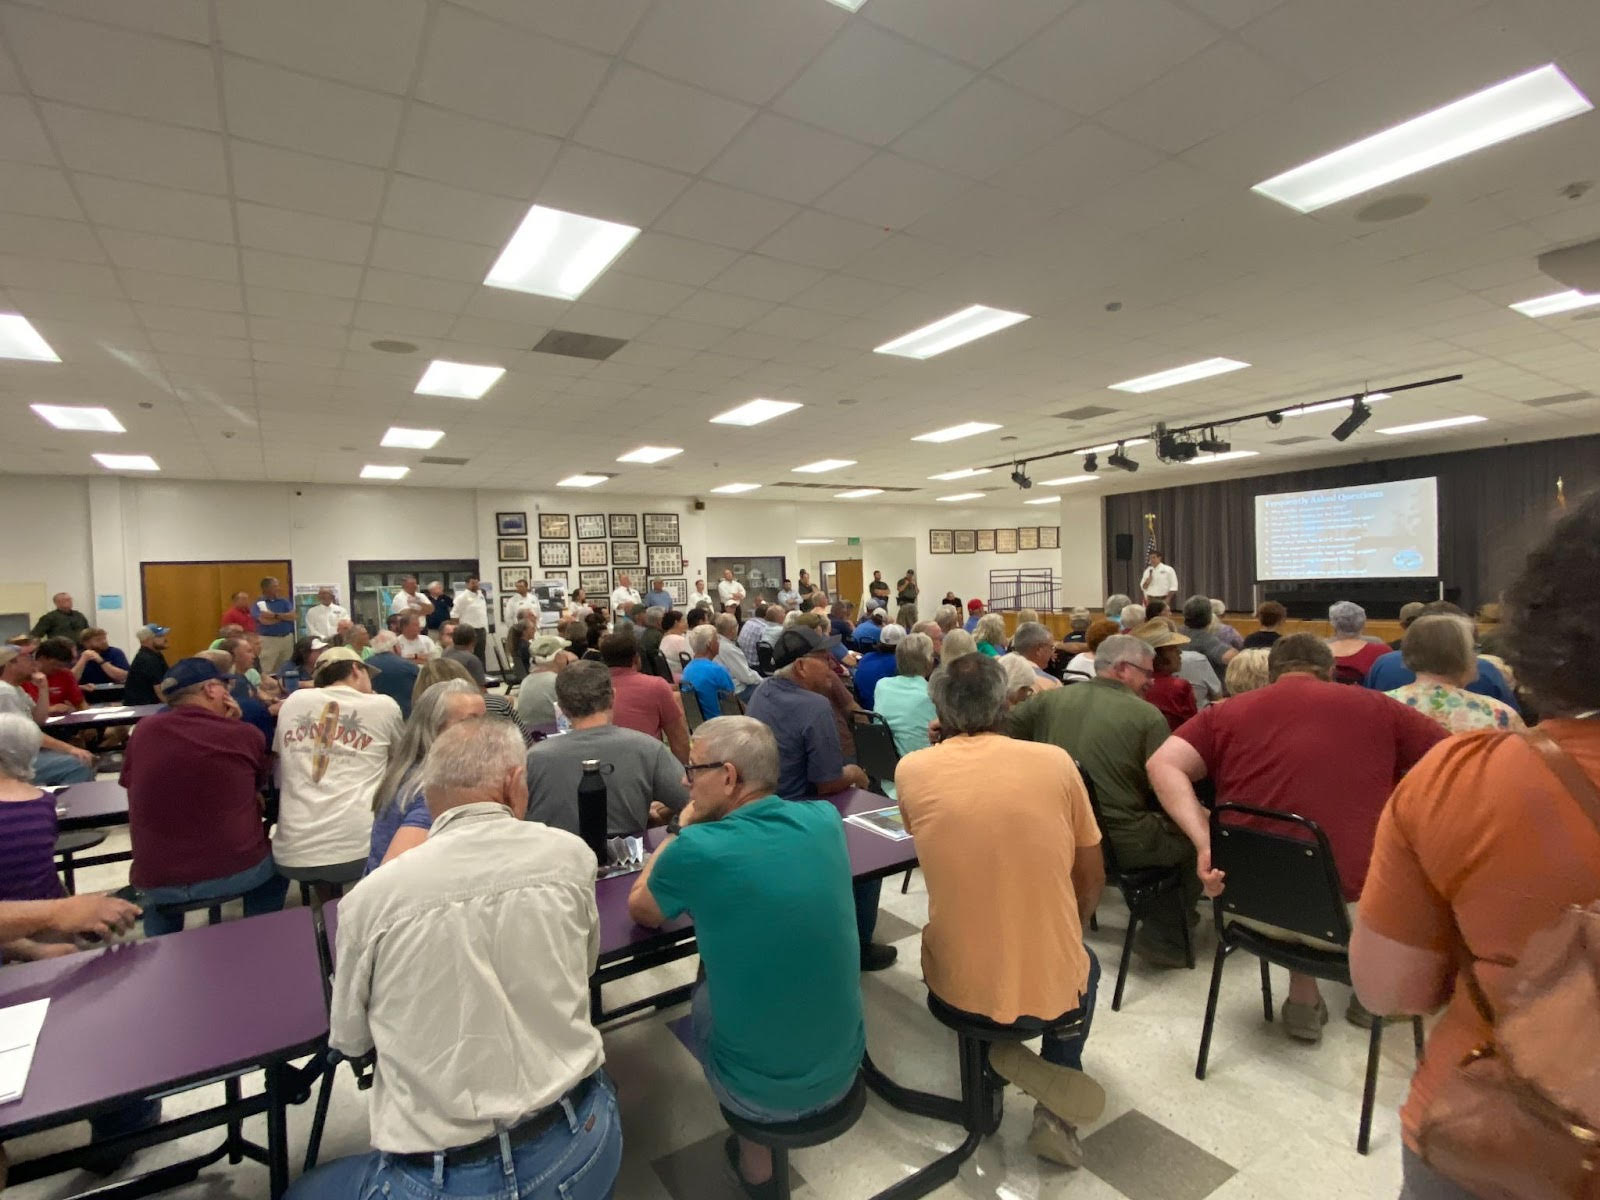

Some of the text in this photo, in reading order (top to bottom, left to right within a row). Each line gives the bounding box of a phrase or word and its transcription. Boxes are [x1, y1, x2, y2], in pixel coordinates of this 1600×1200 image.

[1265, 491, 1384, 508] Frequently Asked Questions
[284, 723, 374, 751] RON JON
